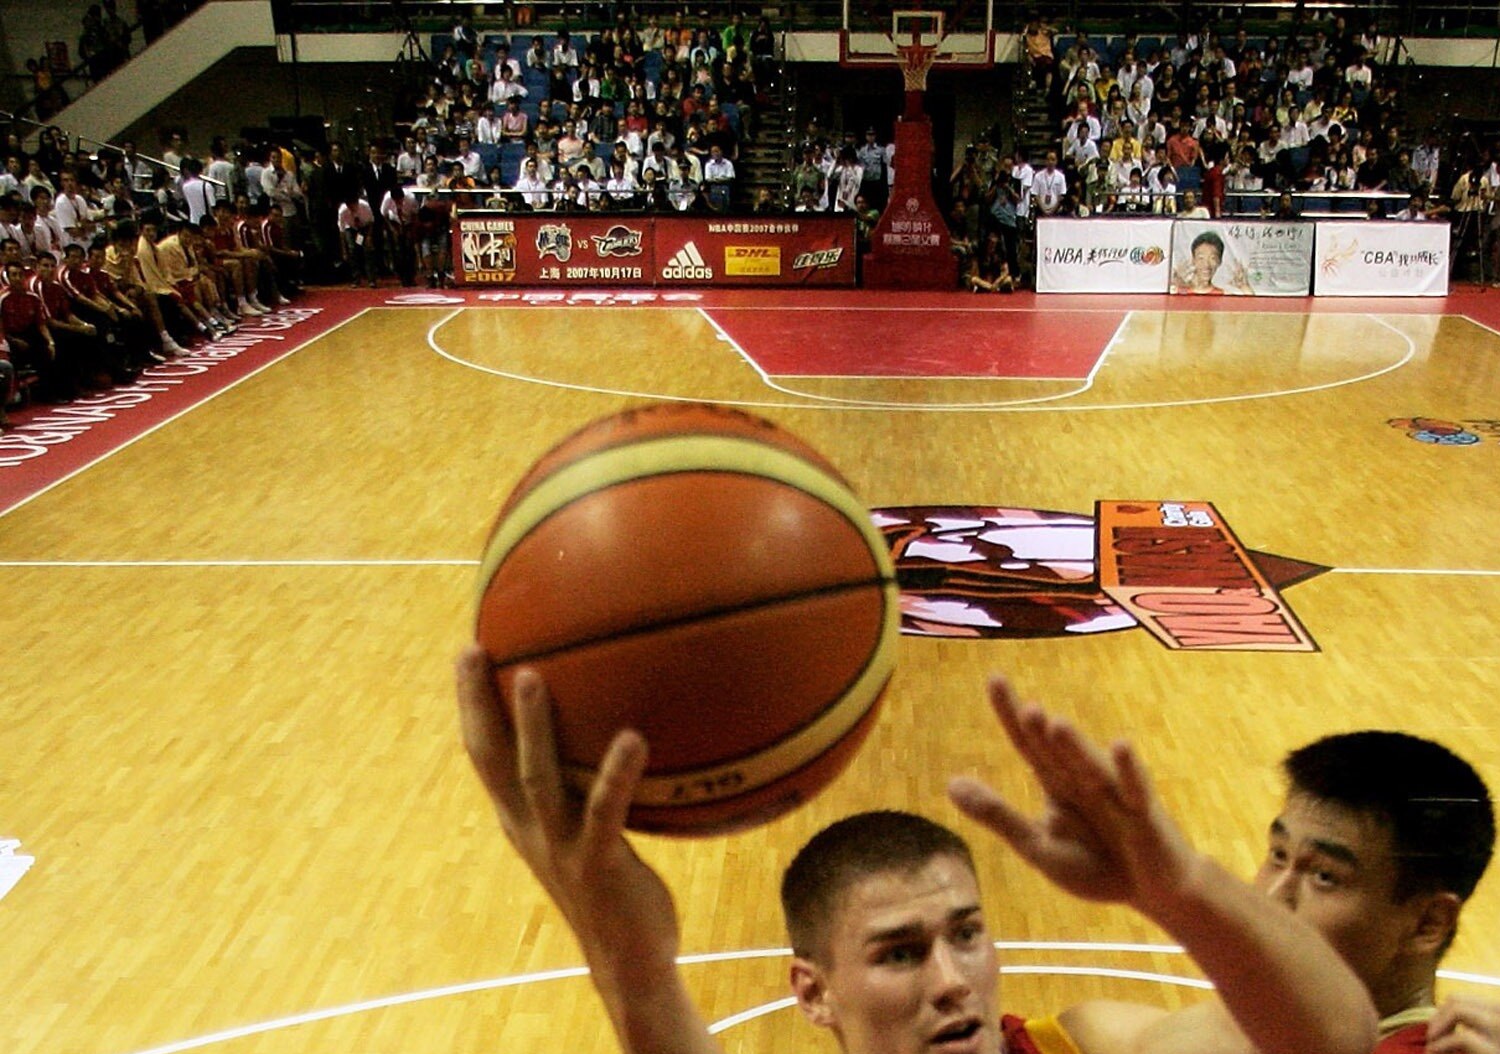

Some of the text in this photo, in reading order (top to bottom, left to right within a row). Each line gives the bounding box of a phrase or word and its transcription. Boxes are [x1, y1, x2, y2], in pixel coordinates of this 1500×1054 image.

[735, 248, 772, 258] DHL
[1053, 247, 1084, 264] NBA
[464, 272, 516, 282] 2007
[539, 268, 642, 279] 上海 2007年10月17日
[662, 266, 713, 279] adidas
